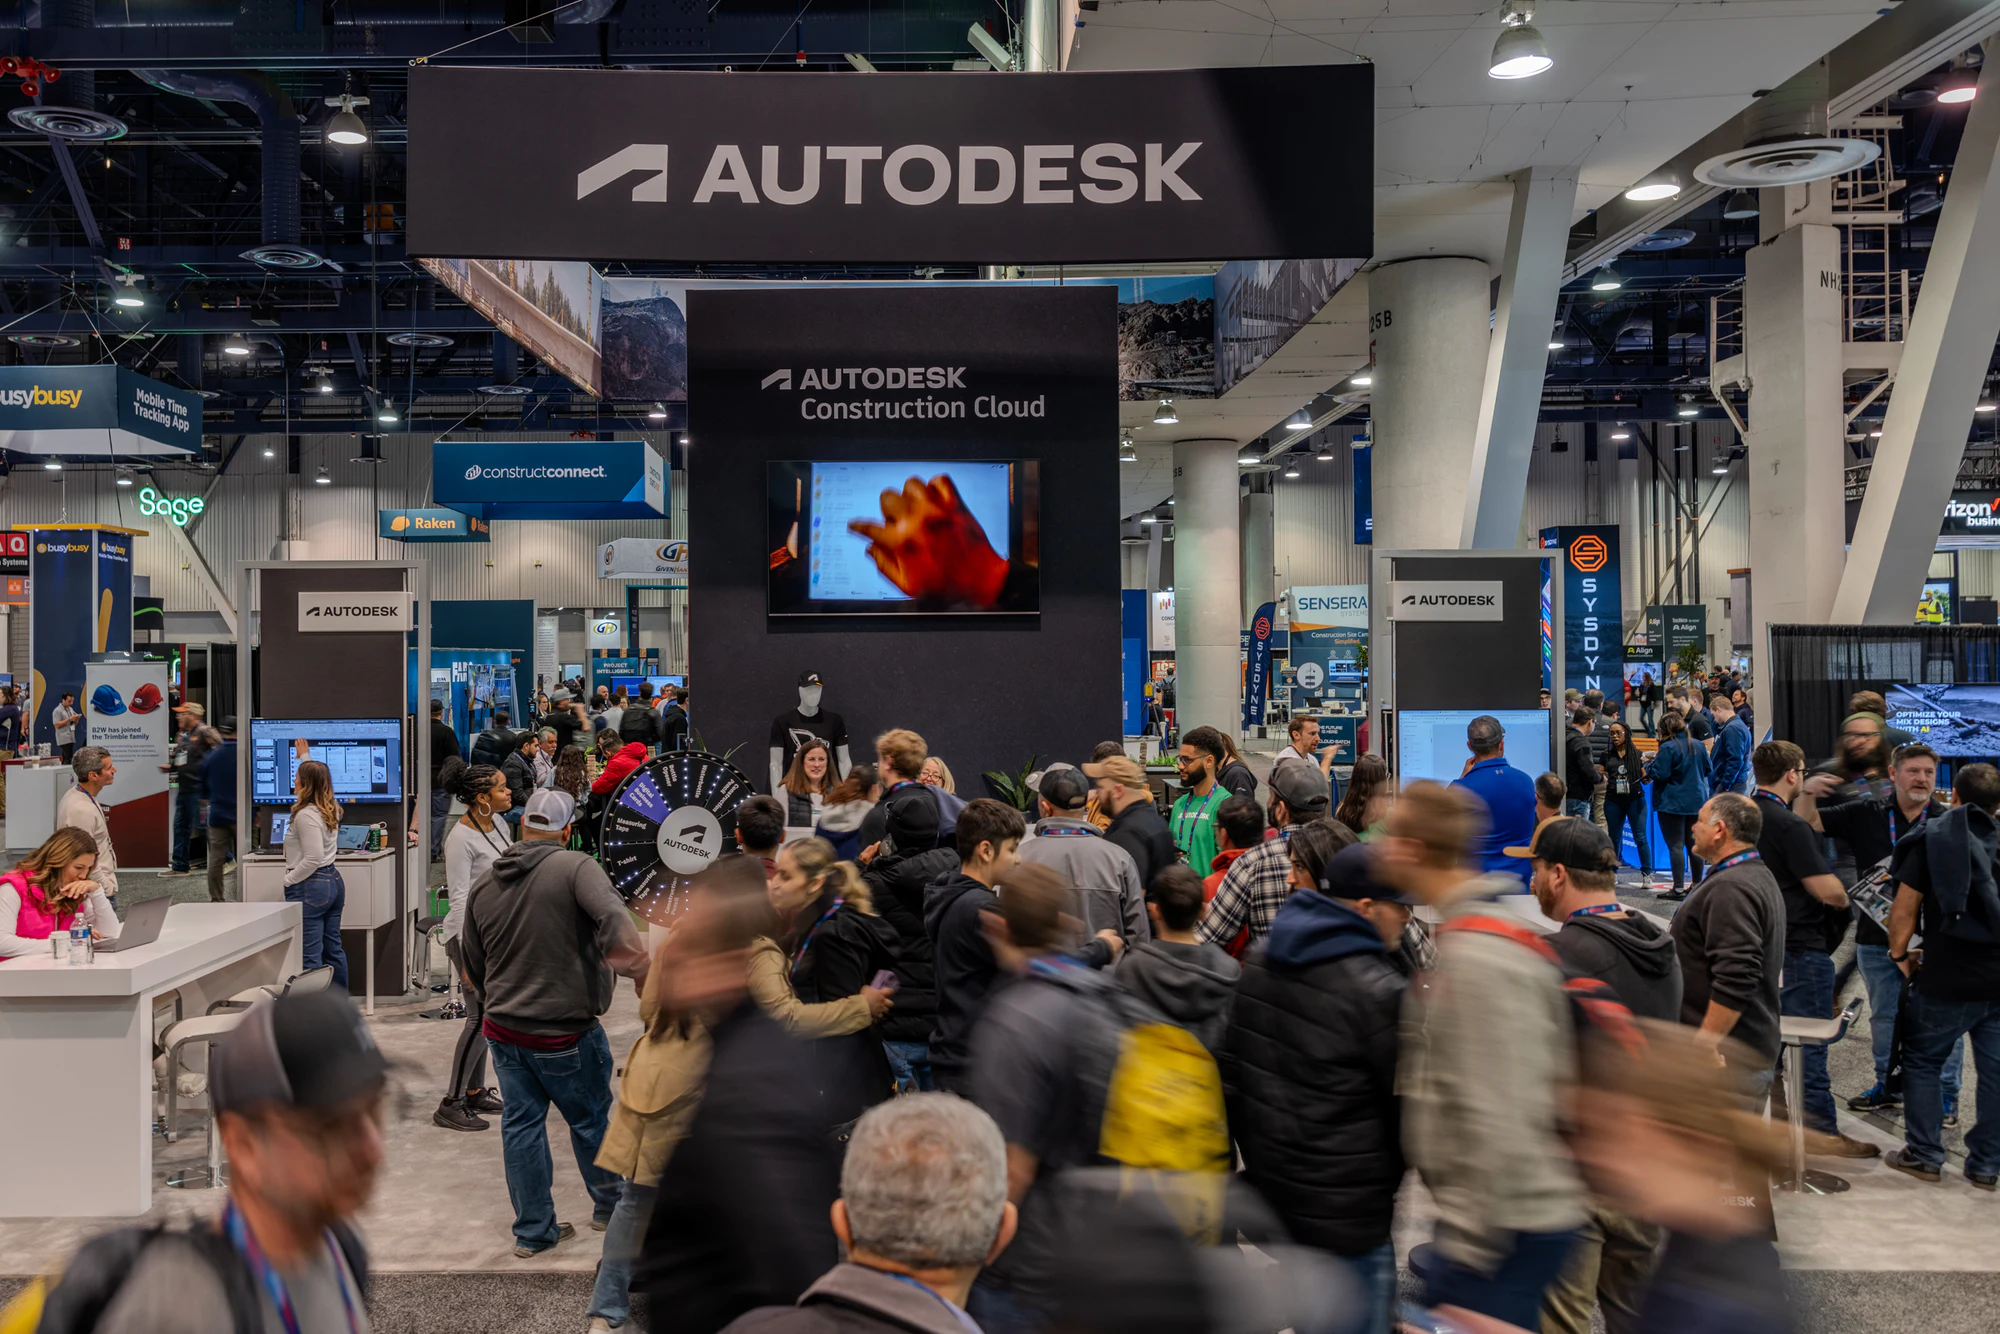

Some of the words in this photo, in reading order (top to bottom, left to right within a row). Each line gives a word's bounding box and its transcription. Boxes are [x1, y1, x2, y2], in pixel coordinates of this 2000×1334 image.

[693, 142, 1203, 205] AUTODESK
[1370, 310, 1392, 333] 25B
[800, 366, 967, 390] AUTODESK
[0, 385, 82, 408] usybusy
[136, 388, 165, 409] Mobile
[167, 398, 187, 416] Time
[801, 395, 965, 419] Construction
[974, 395, 1045, 418] Cloud
[134, 402, 170, 427] Tracking
[172, 418, 190, 432] App
[139, 487, 204, 526] Sage
[1944, 500, 1991, 517] rizon
[415, 517, 455, 529] Raken
[47, 543, 89, 553] busybusy
[2, 558, 28, 567] Systems
[1298, 596, 1368, 610] SENSERA
[1419, 595, 1495, 606] AUTODESK
[323, 606, 398, 617] AUTODESK
[1582, 578, 1601, 690] SYSDYN
[452, 661, 473, 682] FAR
[1250, 641, 1264, 716] SYSDYNE
[662, 766, 672, 787] Opener
[669, 764, 678, 782] Bottle
[694, 764, 708, 798] Waterbottle
[638, 782, 654, 799] Digital
[720, 779, 735, 794] Pencil
[629, 793, 643, 807] Cards
[634, 787, 653, 808] Business
[712, 784, 739, 813] Construction
[615, 824, 630, 833] Tape
[617, 817, 647, 830] Measuring
[663, 838, 711, 859] AUTODESK
[617, 855, 638, 866] T-shirt
[633, 869, 658, 896] Measuring
[638, 887, 651, 900] Tape
[664, 876, 678, 914] Construction
[671, 897, 680, 915] Pencil
